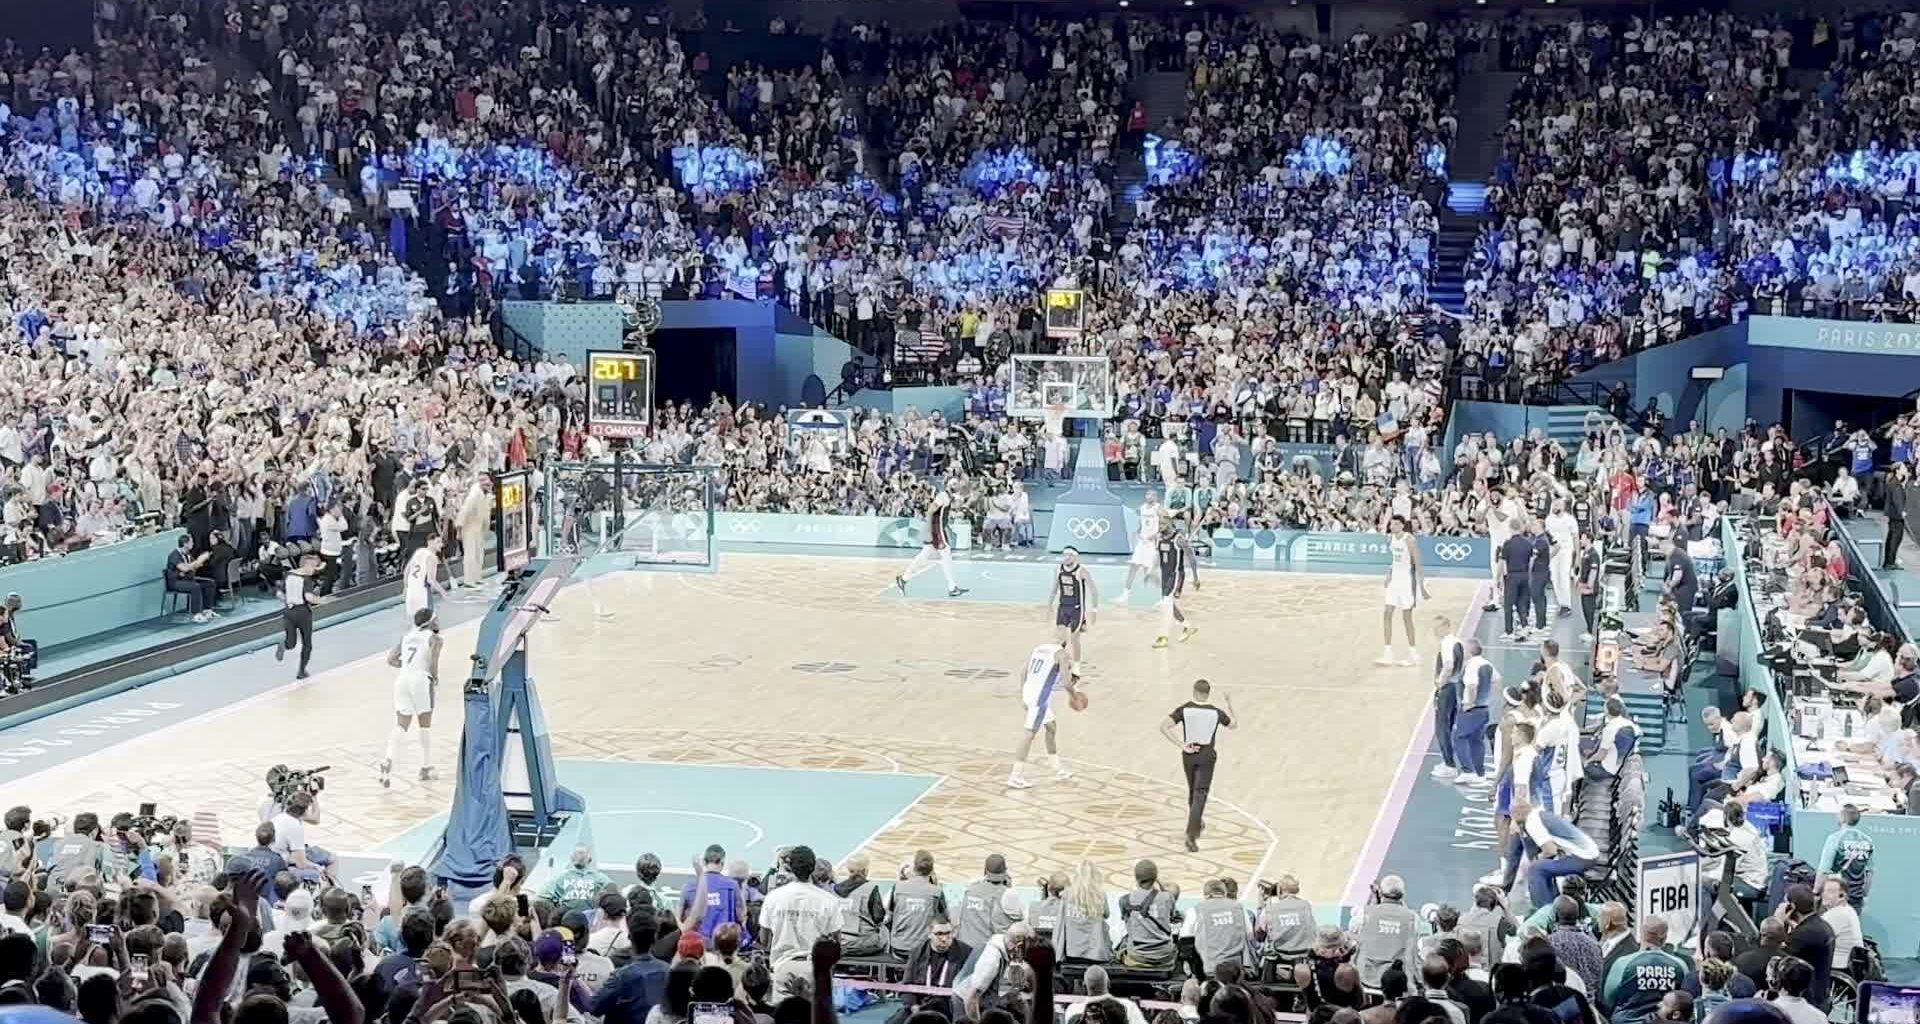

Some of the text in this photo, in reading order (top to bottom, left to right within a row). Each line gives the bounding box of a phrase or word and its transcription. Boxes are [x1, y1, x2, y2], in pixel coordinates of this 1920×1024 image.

[1818, 327, 1876, 348] PARIS
[412, 564, 421, 580] 2
[408, 647, 417, 664] 7
[1031, 658, 1044, 674] 10
[1650, 883, 1689, 915] FIBA
[1636, 965, 1676, 979] PARIS
[1637, 978, 1676, 991] 2024
